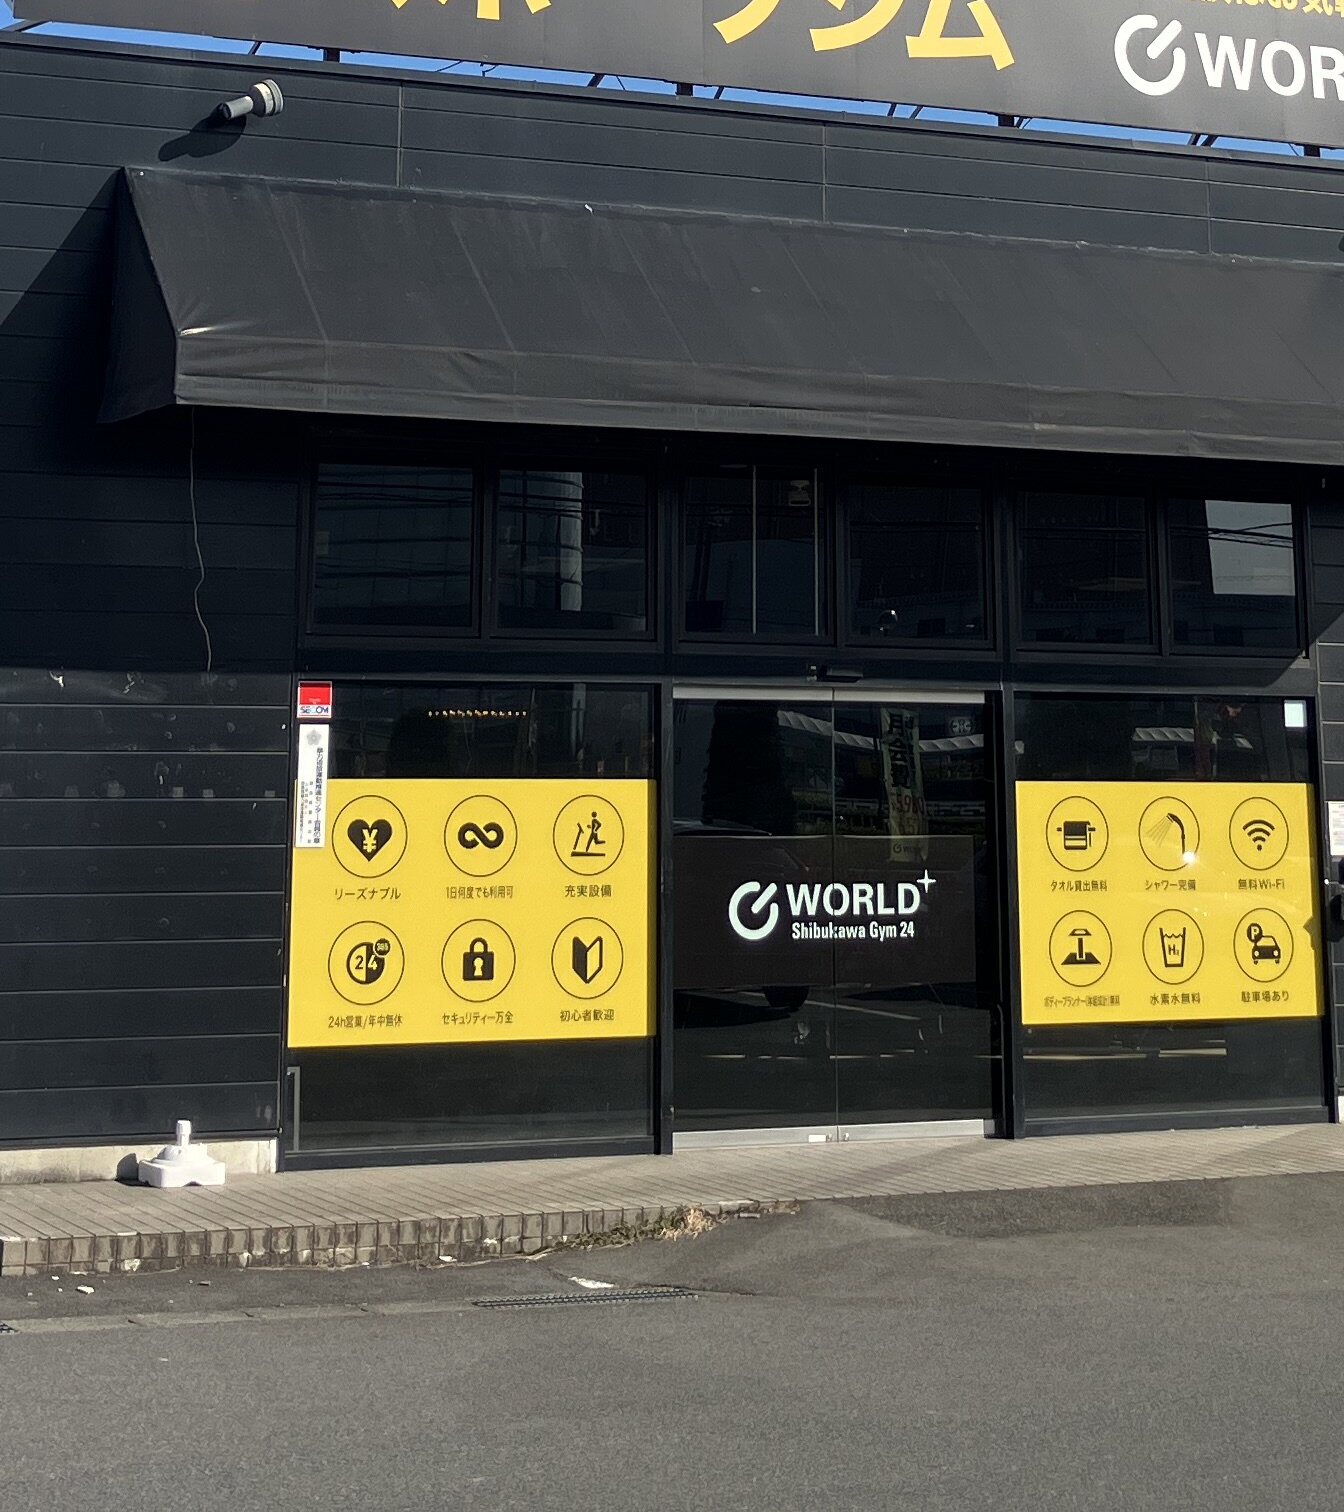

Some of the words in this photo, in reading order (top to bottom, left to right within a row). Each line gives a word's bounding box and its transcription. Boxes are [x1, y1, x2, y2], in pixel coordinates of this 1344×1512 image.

[334, 887, 401, 901] リーズナブル
[564, 884, 612, 898] 充実設備
[792, 922, 865, 939] Shibukawa
[869, 921, 897, 942] Gym
[899, 921, 914, 937] 24
[1240, 990, 1290, 1003] 駐車場あり
[442, 1010, 514, 1025] セキュリティー万全
[560, 1008, 615, 1022] 初心者歓迎
